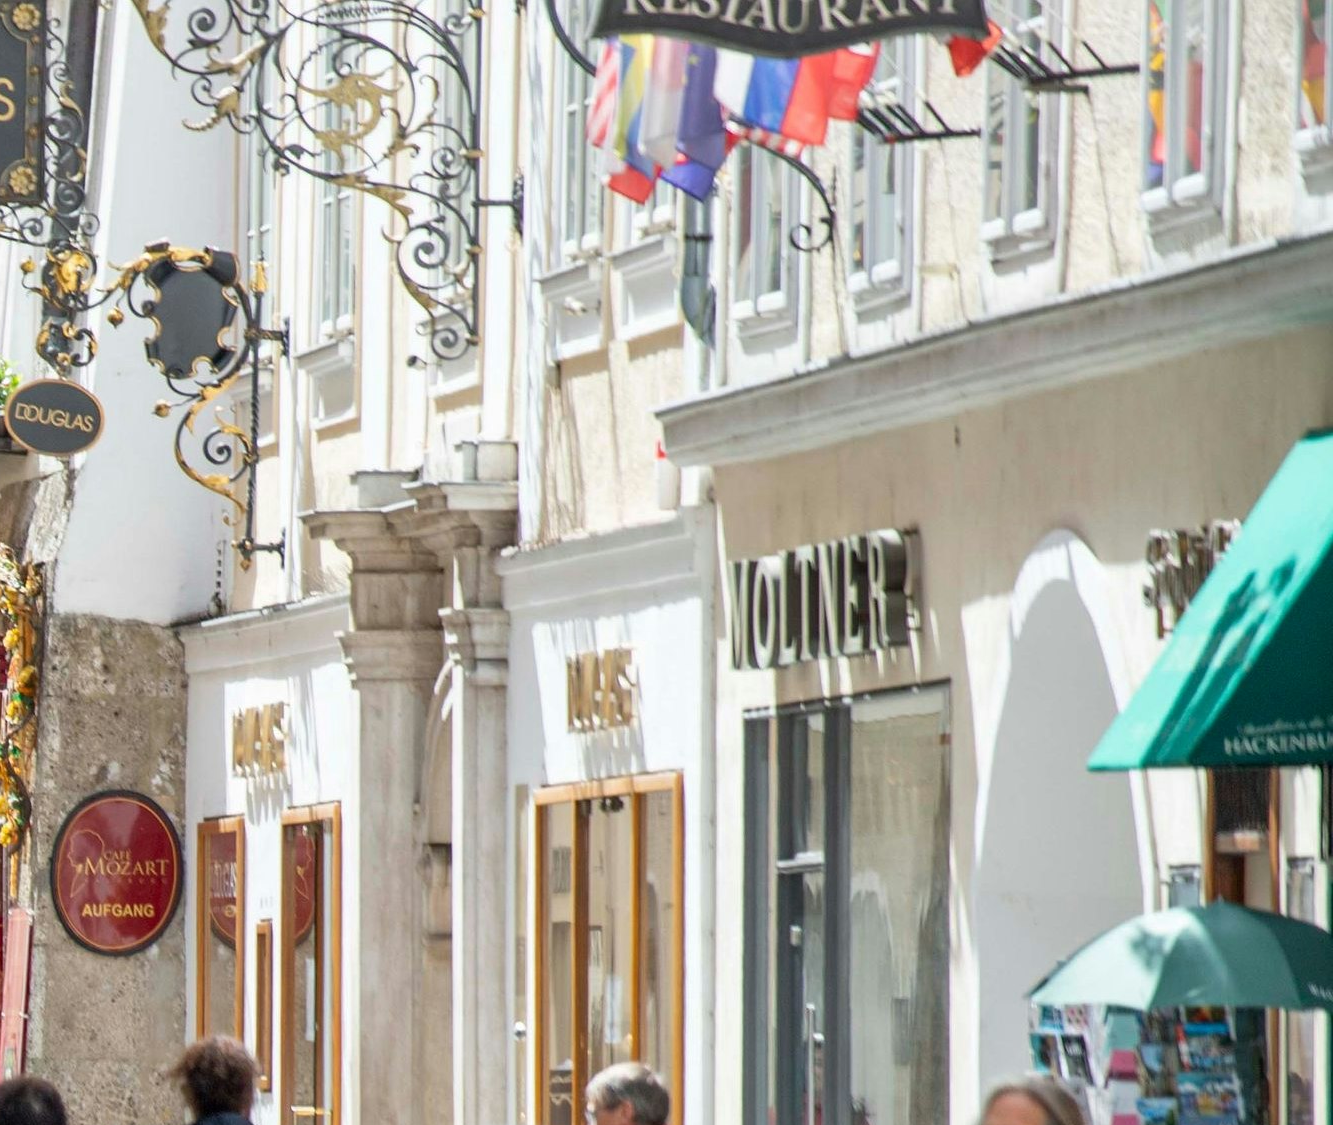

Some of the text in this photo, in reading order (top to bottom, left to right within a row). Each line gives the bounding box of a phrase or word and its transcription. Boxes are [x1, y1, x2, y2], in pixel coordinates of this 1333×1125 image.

[14, 402, 94, 433] DOUGLAS
[84, 856, 170, 876] MOZART
[81, 902, 156, 918] AUFGANG
